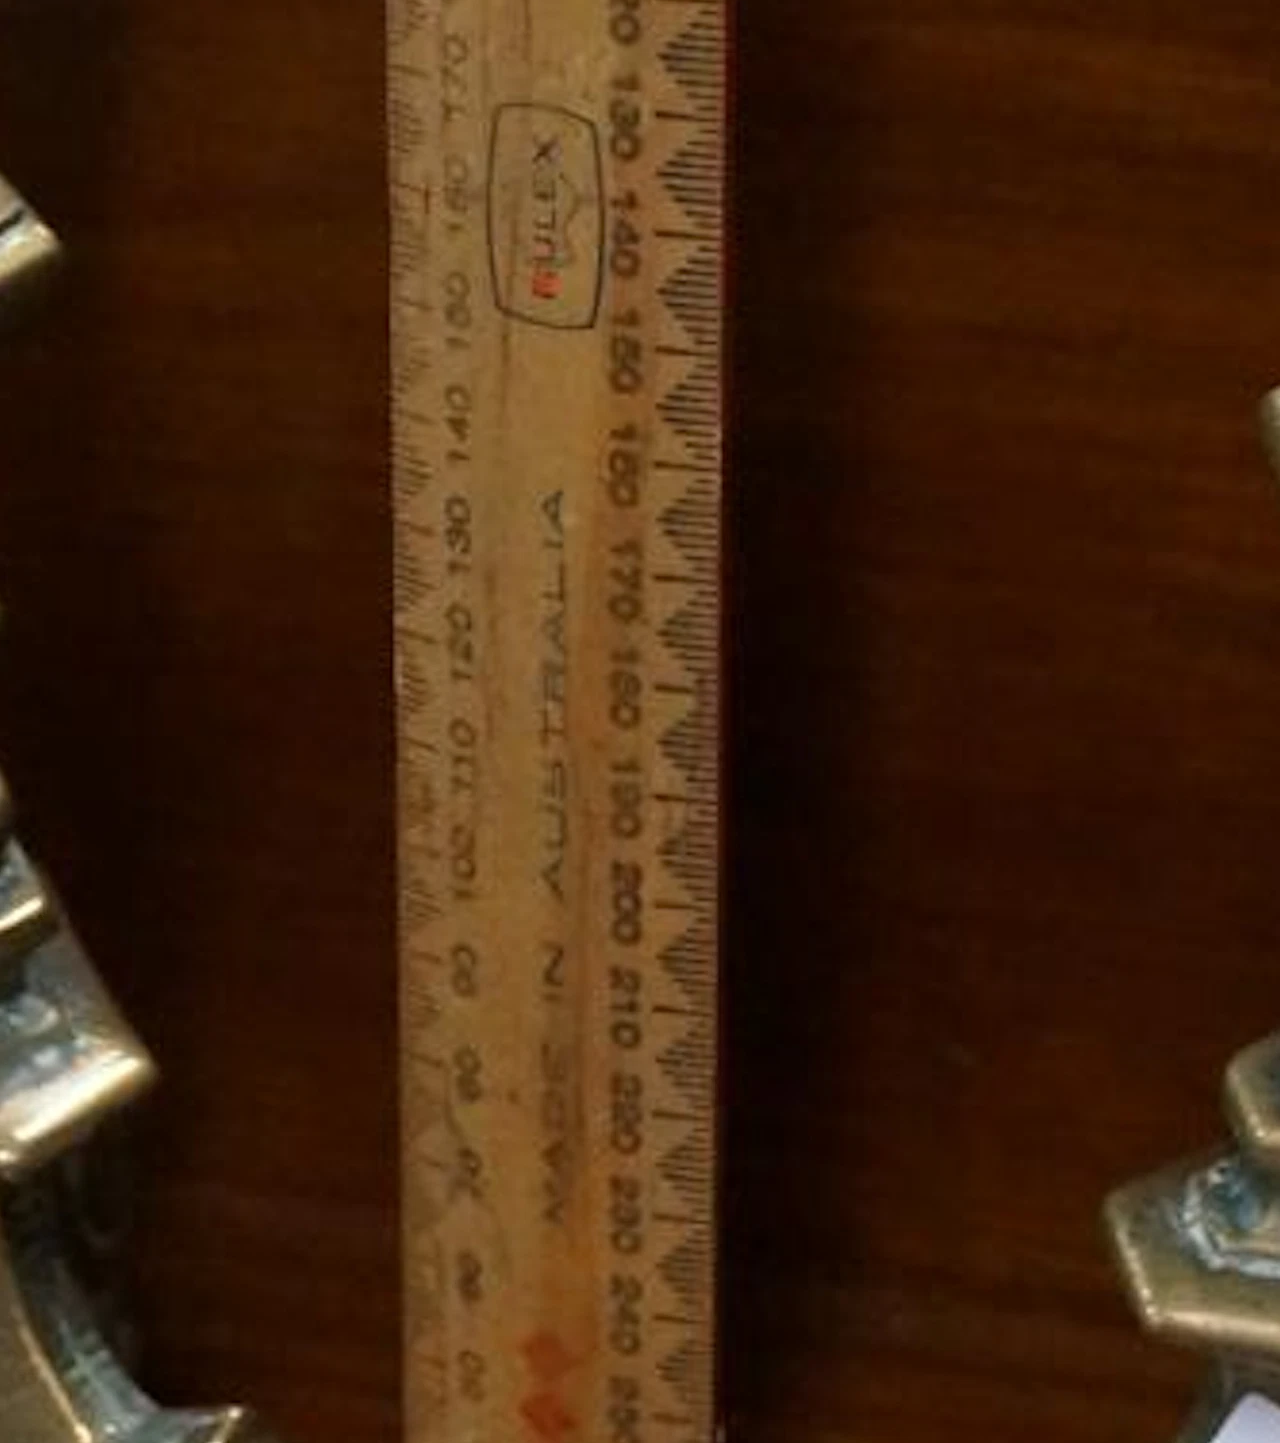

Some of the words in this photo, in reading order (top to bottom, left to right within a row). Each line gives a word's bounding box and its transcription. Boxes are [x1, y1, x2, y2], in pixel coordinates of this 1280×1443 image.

[439, 35, 470, 122] 170
[608, 75, 645, 164] 130
[531, 135, 562, 300] RULEX
[608, 191, 645, 278] 140
[608, 316, 645, 396] 150
[444, 384, 472, 463] 140
[608, 423, 645, 509] 160
[445, 496, 472, 576] 130
[608, 541, 645, 620] 170
[446, 602, 474, 683] 120
[540, 489, 566, 902] AUSTRALIA
[608, 648, 645, 730] 180
[448, 716, 475, 795] 110
[608, 761, 645, 841] 190
[448, 823, 476, 902] 100
[608, 862, 645, 946] 200
[449, 943, 477, 997] 90
[540, 941, 566, 1003] IN
[608, 967, 645, 1049] 210
[540, 1042, 566, 1225] MADE
[608, 1073, 645, 1156] 220
[608, 1174, 645, 1256] 230
[608, 1275, 645, 1357] 240
